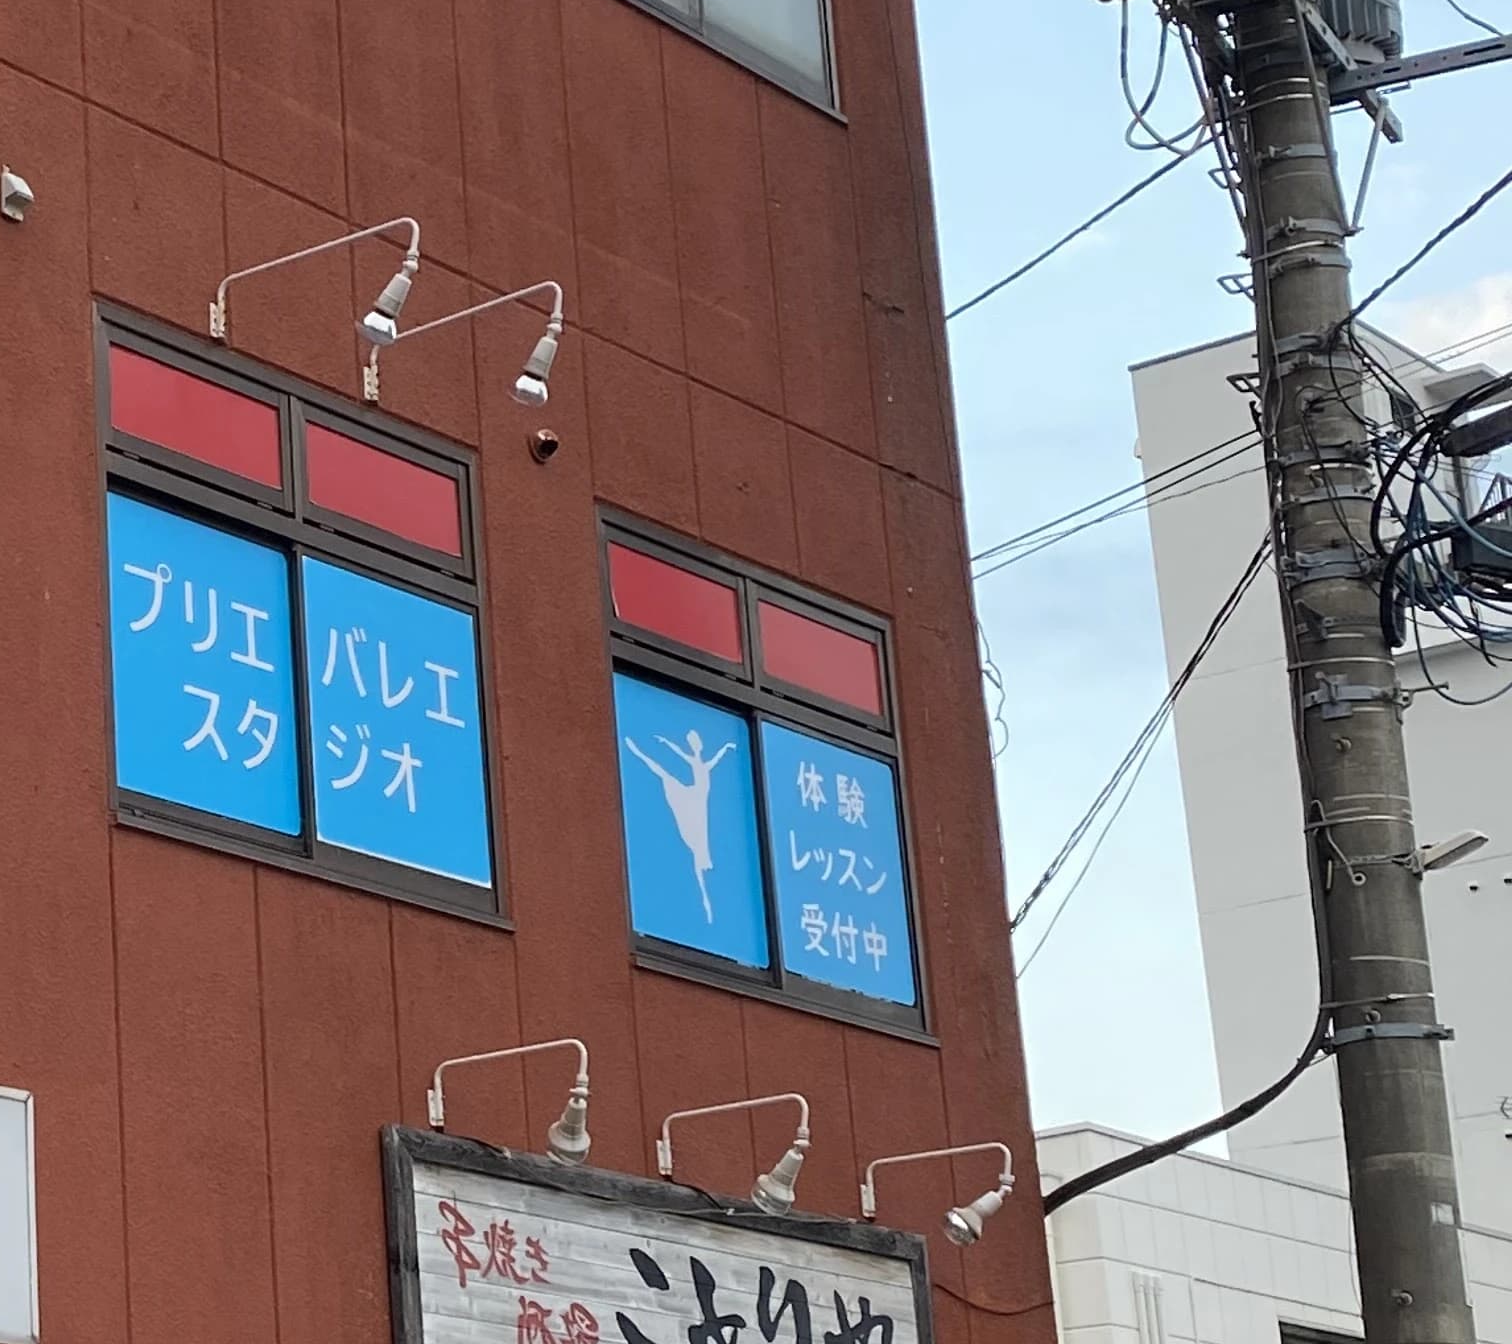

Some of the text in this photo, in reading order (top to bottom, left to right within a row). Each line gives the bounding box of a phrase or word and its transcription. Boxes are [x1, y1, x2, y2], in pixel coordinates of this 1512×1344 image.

[123, 562, 466, 730] プリエ バレエ
[796, 760, 868, 829] 体験
[789, 828, 889, 897] レッスン
[799, 903, 890, 973] 受付中
